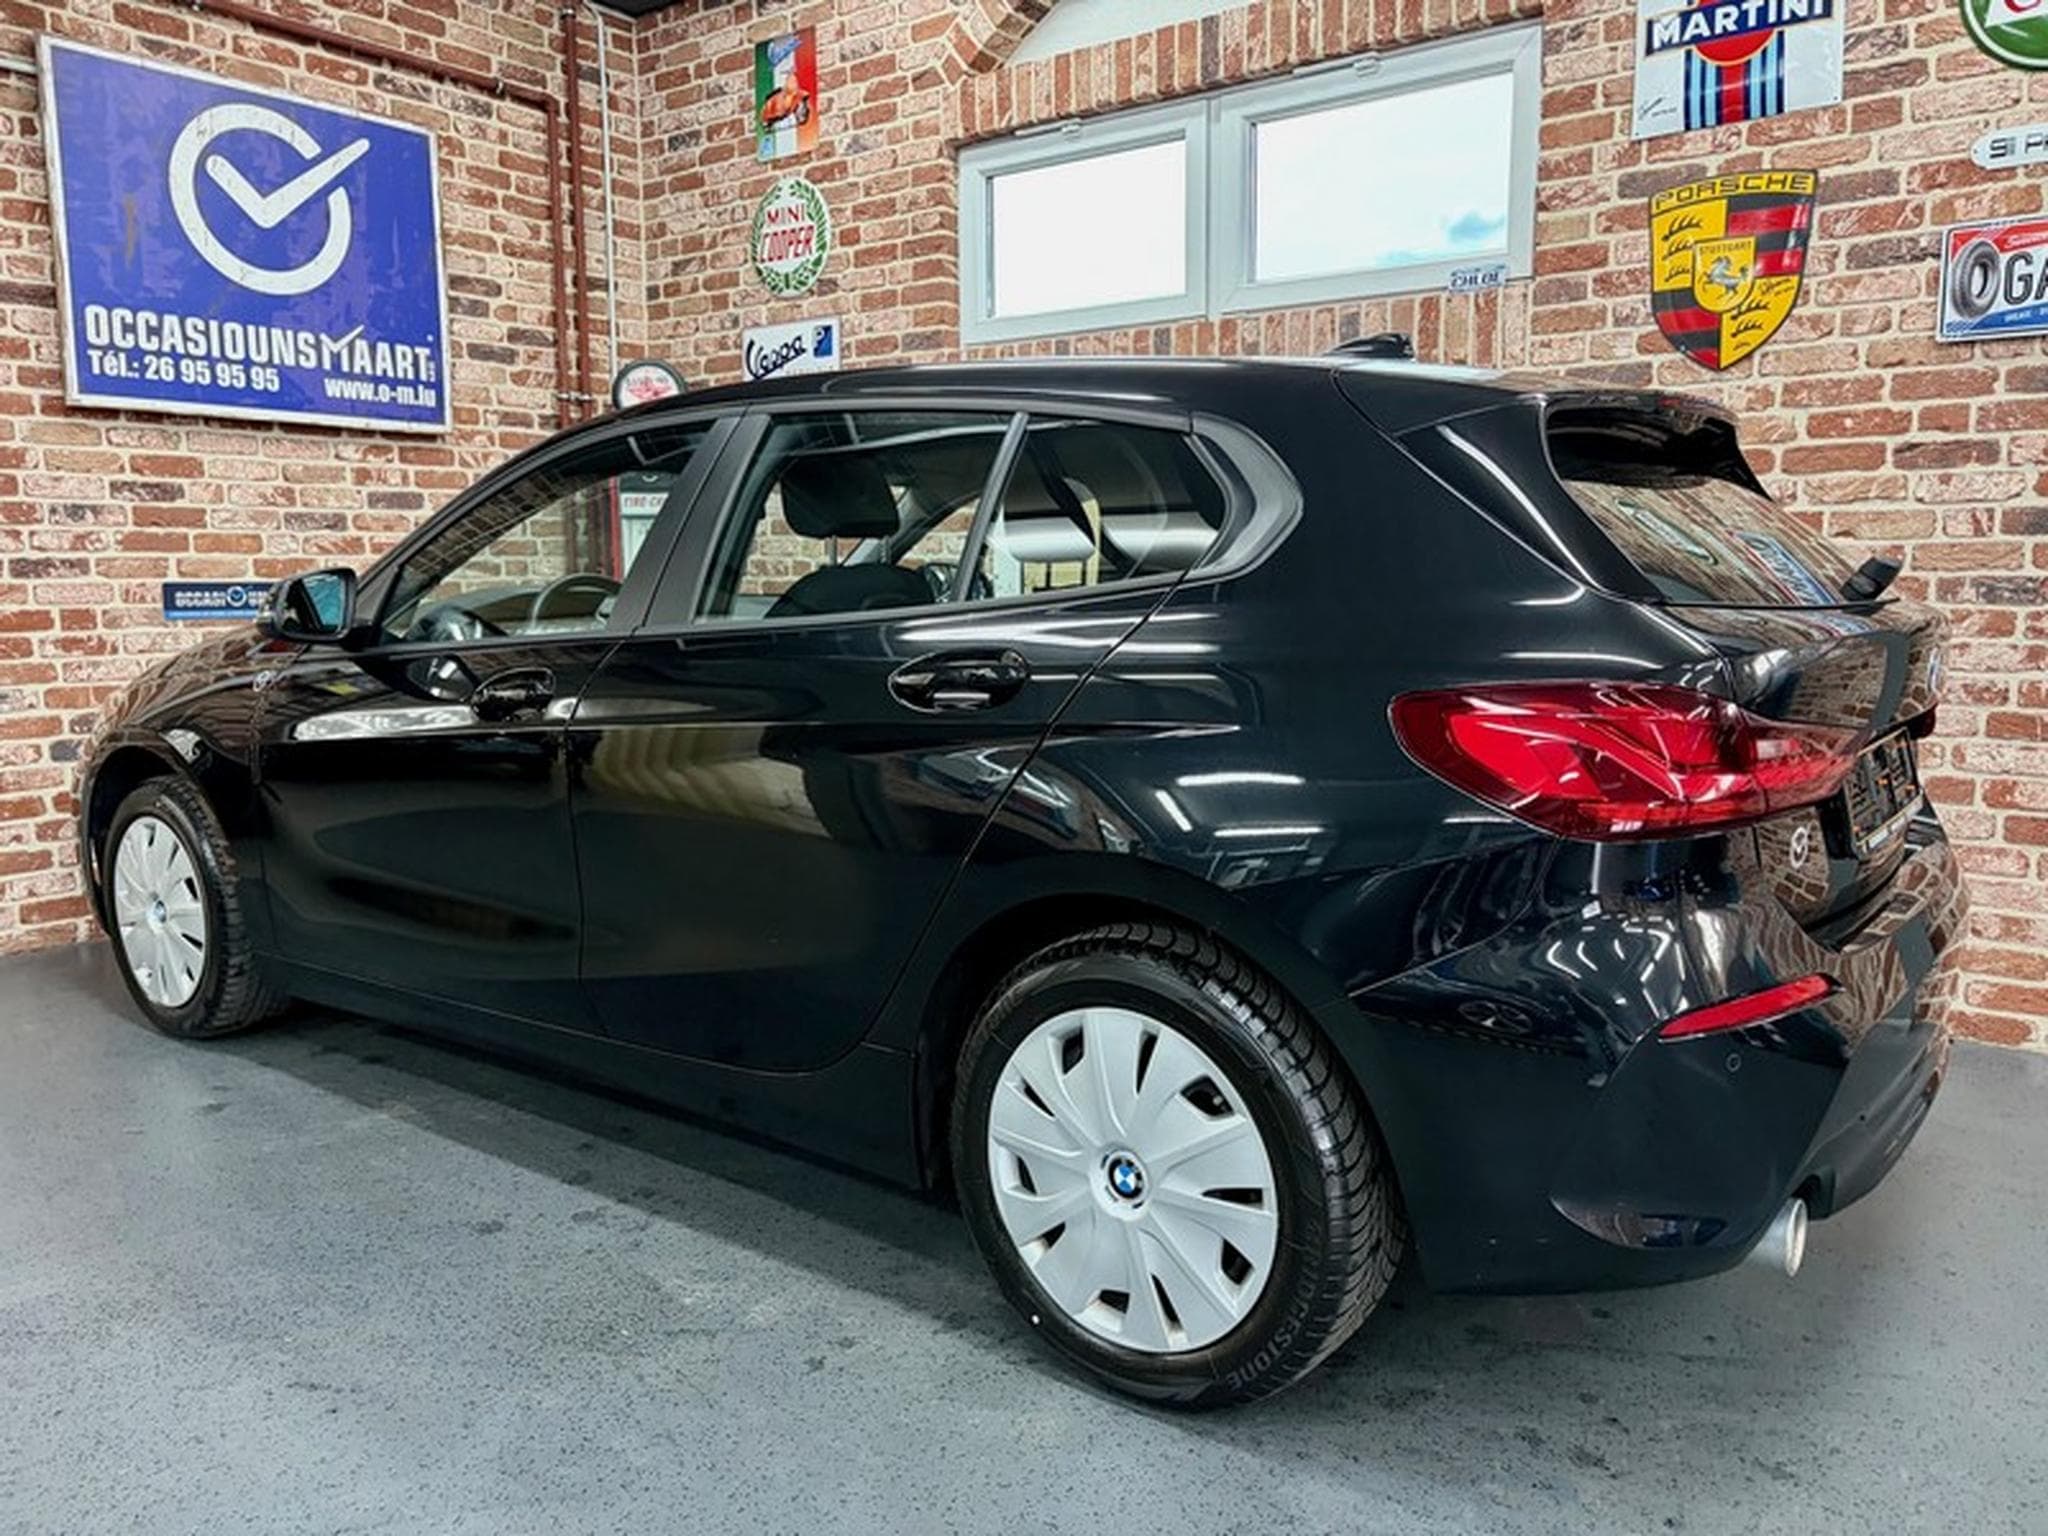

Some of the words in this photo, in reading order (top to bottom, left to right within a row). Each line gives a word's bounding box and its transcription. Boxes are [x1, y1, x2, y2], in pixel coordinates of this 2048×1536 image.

[1652, 0, 1824, 49] MARTINI
[1656, 173, 1811, 210] PORSCHE
[767, 203, 805, 223] MINI
[760, 224, 815, 263] COOPER
[87, 350, 140, 378] Tél.:
[144, 355, 175, 382] 26
[180, 358, 211, 385] 95
[216, 362, 246, 389] 95
[251, 366, 280, 392] 95
[745, 336, 807, 379] Vespa
[324, 378, 436, 407] www.o-m.lu
